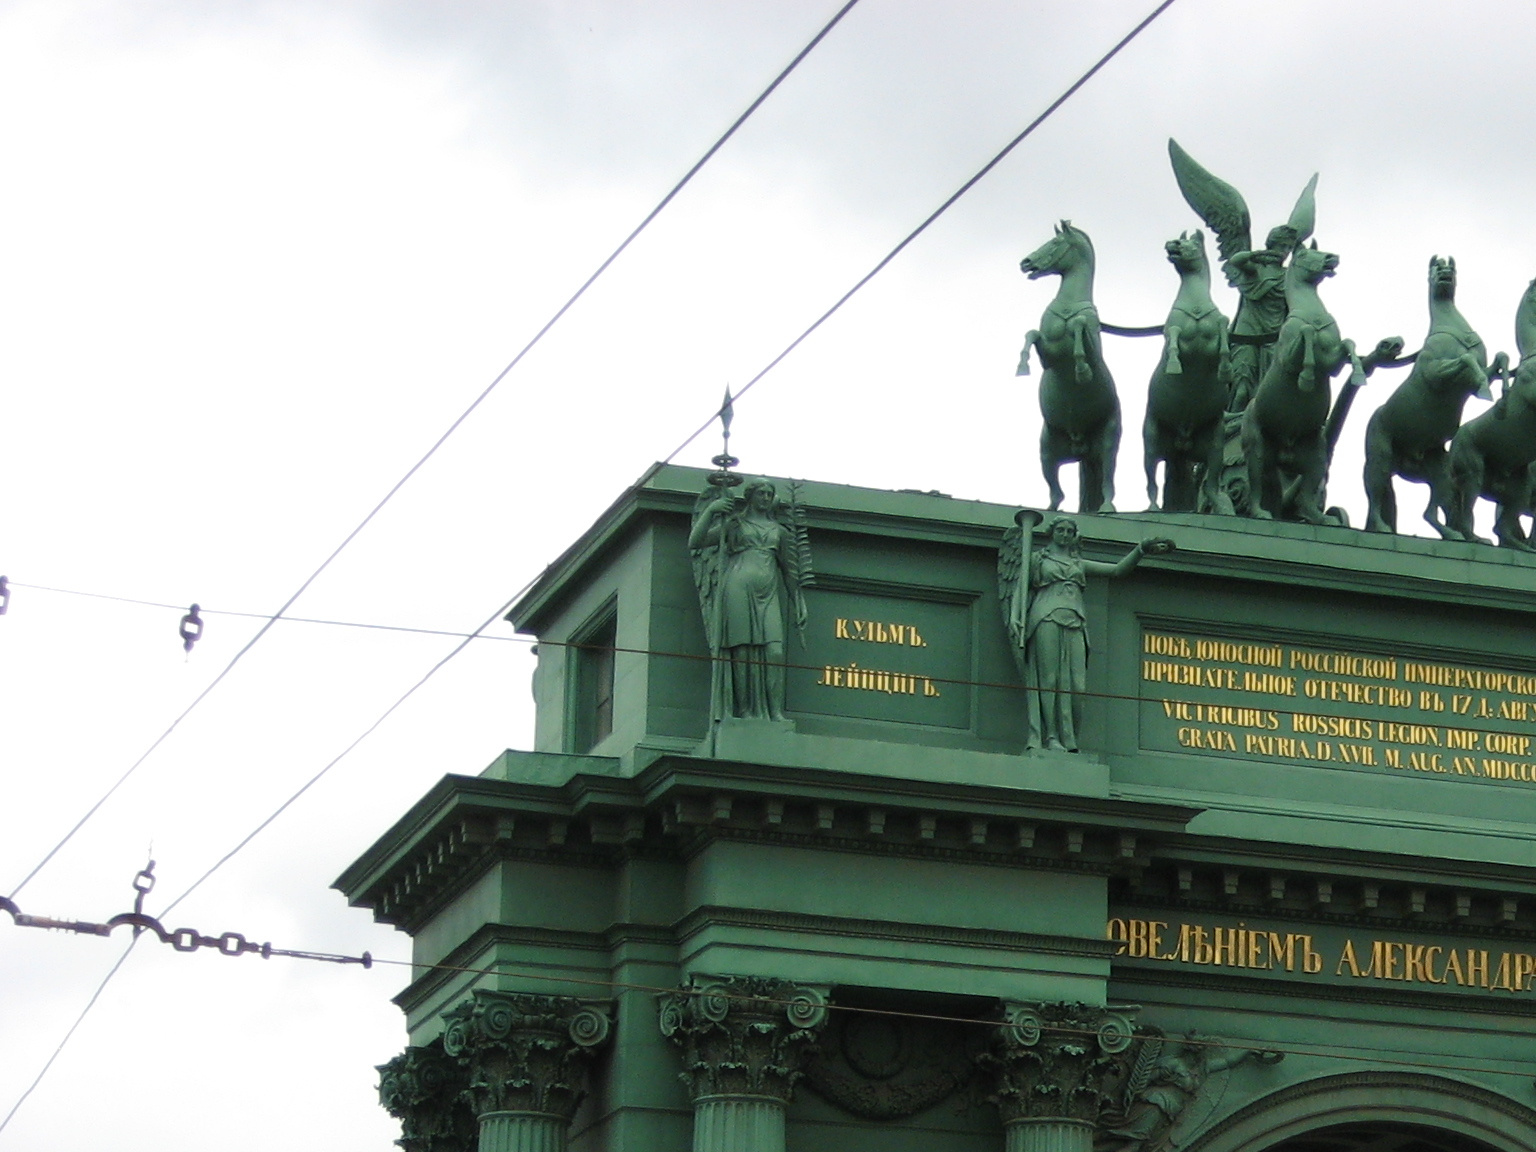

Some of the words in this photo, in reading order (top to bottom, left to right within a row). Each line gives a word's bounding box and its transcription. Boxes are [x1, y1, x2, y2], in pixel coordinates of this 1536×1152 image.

[835, 617, 927, 648] КУЛЬМЪ.
[1143, 660, 1297, 697] ПРИЗНАТЕЛЬНОЕ
[1304, 678, 1413, 709] ОТЕЧЕСТВО
[1419, 690, 1444, 712] ВЪ
[1452, 694, 1473, 715] 17
[1162, 698, 1280, 731] VICTRICIBUS
[1292, 712, 1373, 740] ROSSICIS
[1446, 729, 1481, 751] IMP.
[1485, 732, 1532, 757] CORP.
[1177, 726, 1237, 752] GRATA
